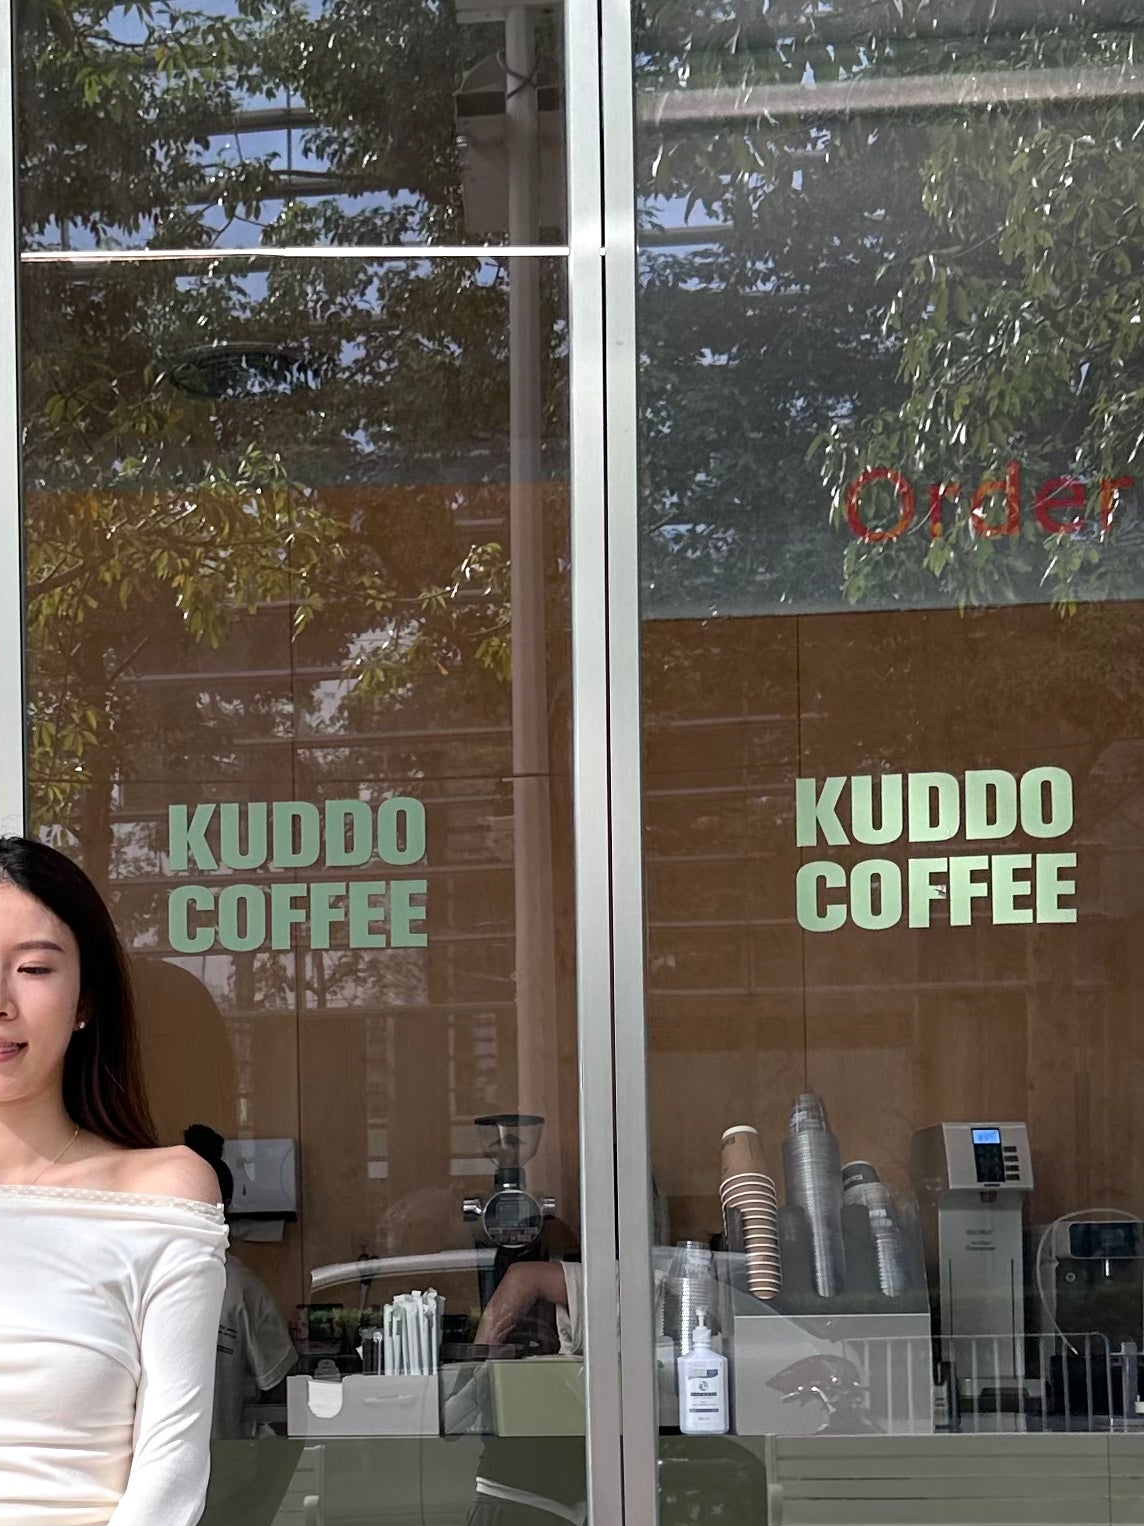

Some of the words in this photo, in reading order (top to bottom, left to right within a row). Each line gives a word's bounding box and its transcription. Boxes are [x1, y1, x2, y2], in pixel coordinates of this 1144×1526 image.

[847, 461, 1135, 542] Order
[168, 796, 426, 871] KUDDO
[796, 767, 1074, 847] KUDDO
[168, 880, 428, 953] COFFEE
[796, 853, 1077, 932] COFFEE
